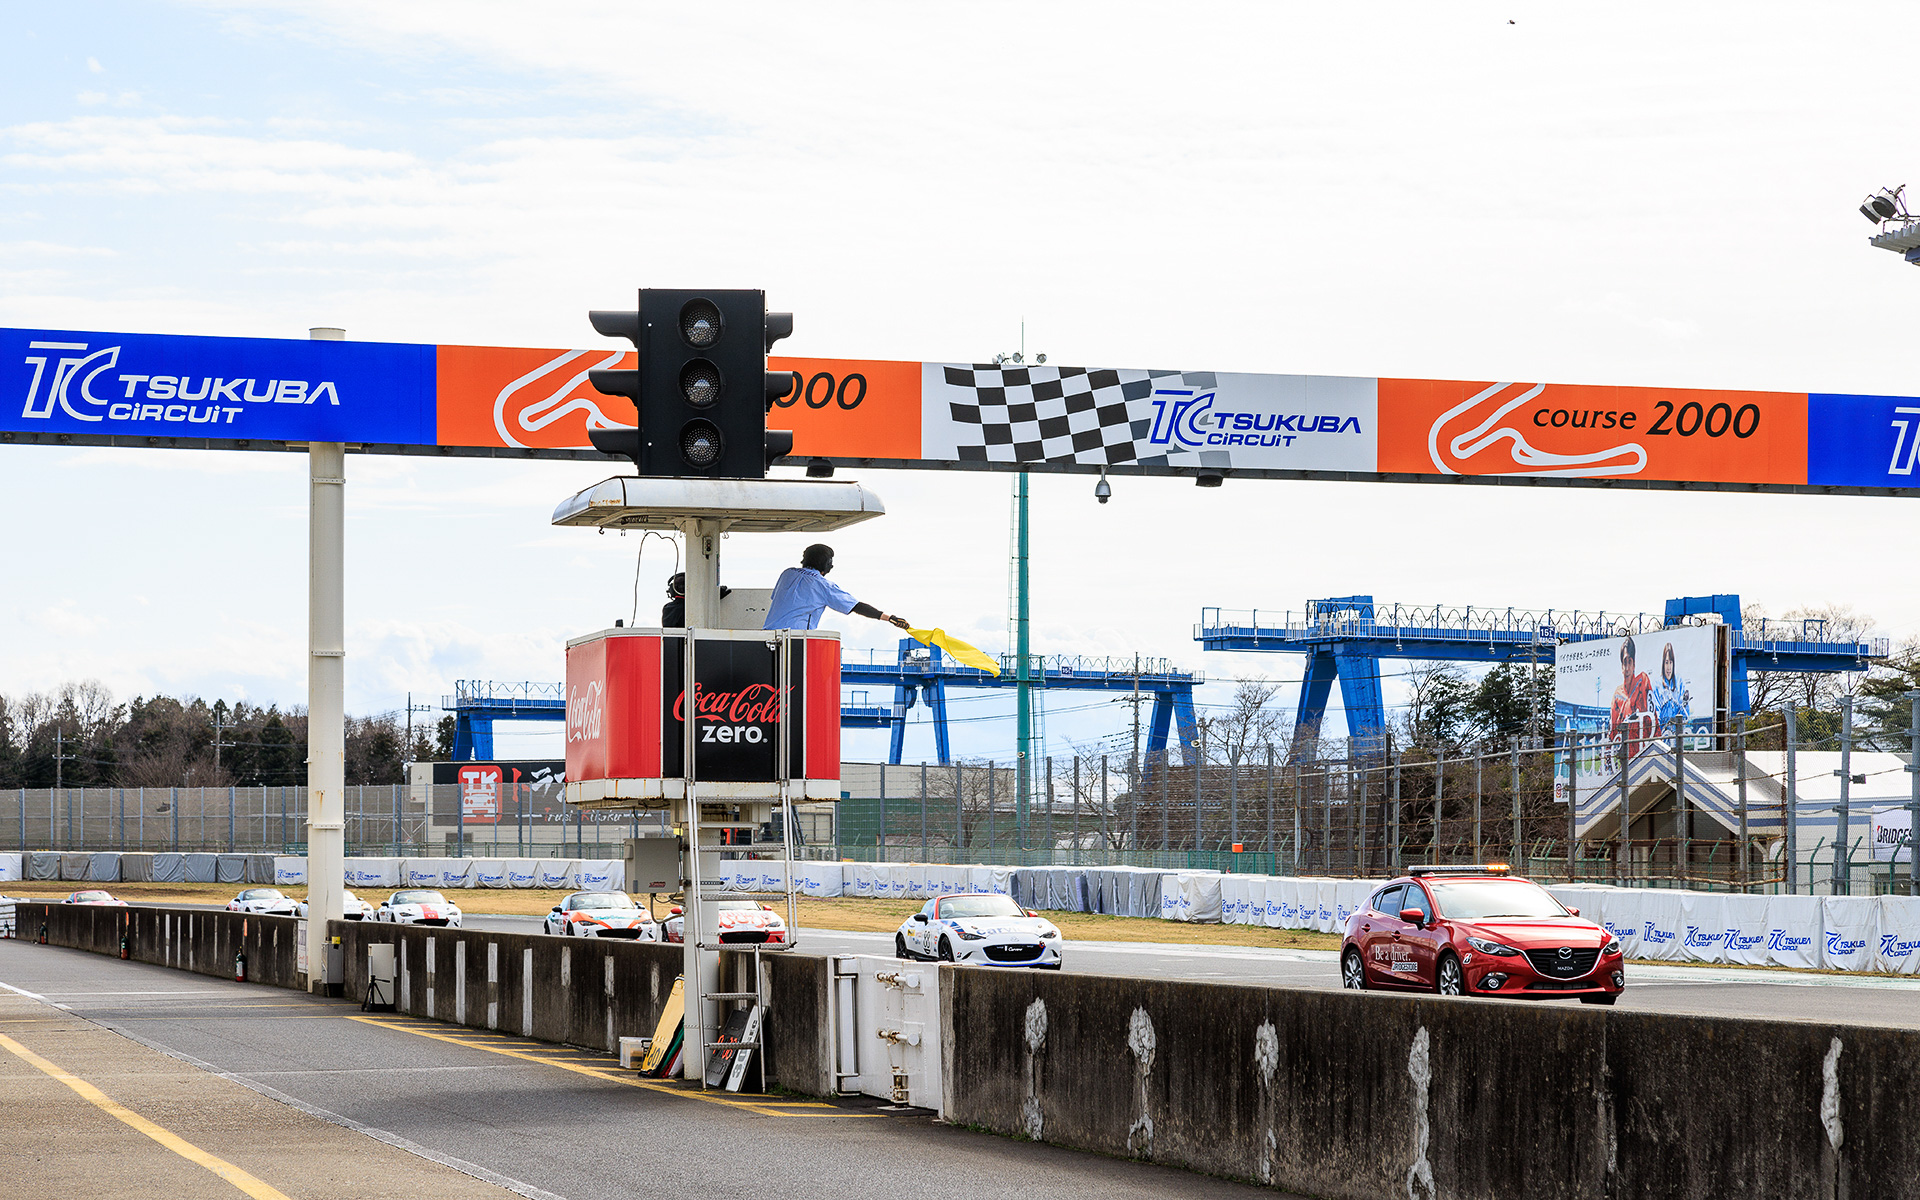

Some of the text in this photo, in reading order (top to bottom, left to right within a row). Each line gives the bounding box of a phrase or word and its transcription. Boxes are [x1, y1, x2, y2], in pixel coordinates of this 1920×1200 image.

[118, 374, 340, 406] TSUKUBA
[1213, 412, 1361, 434] TSUKUBA
[1533, 401, 1760, 438] course 2000
[1888, 407, 1920, 476] T
[673, 682, 795, 723] Coca-Cola
[1375, 945, 1384, 960] Be
